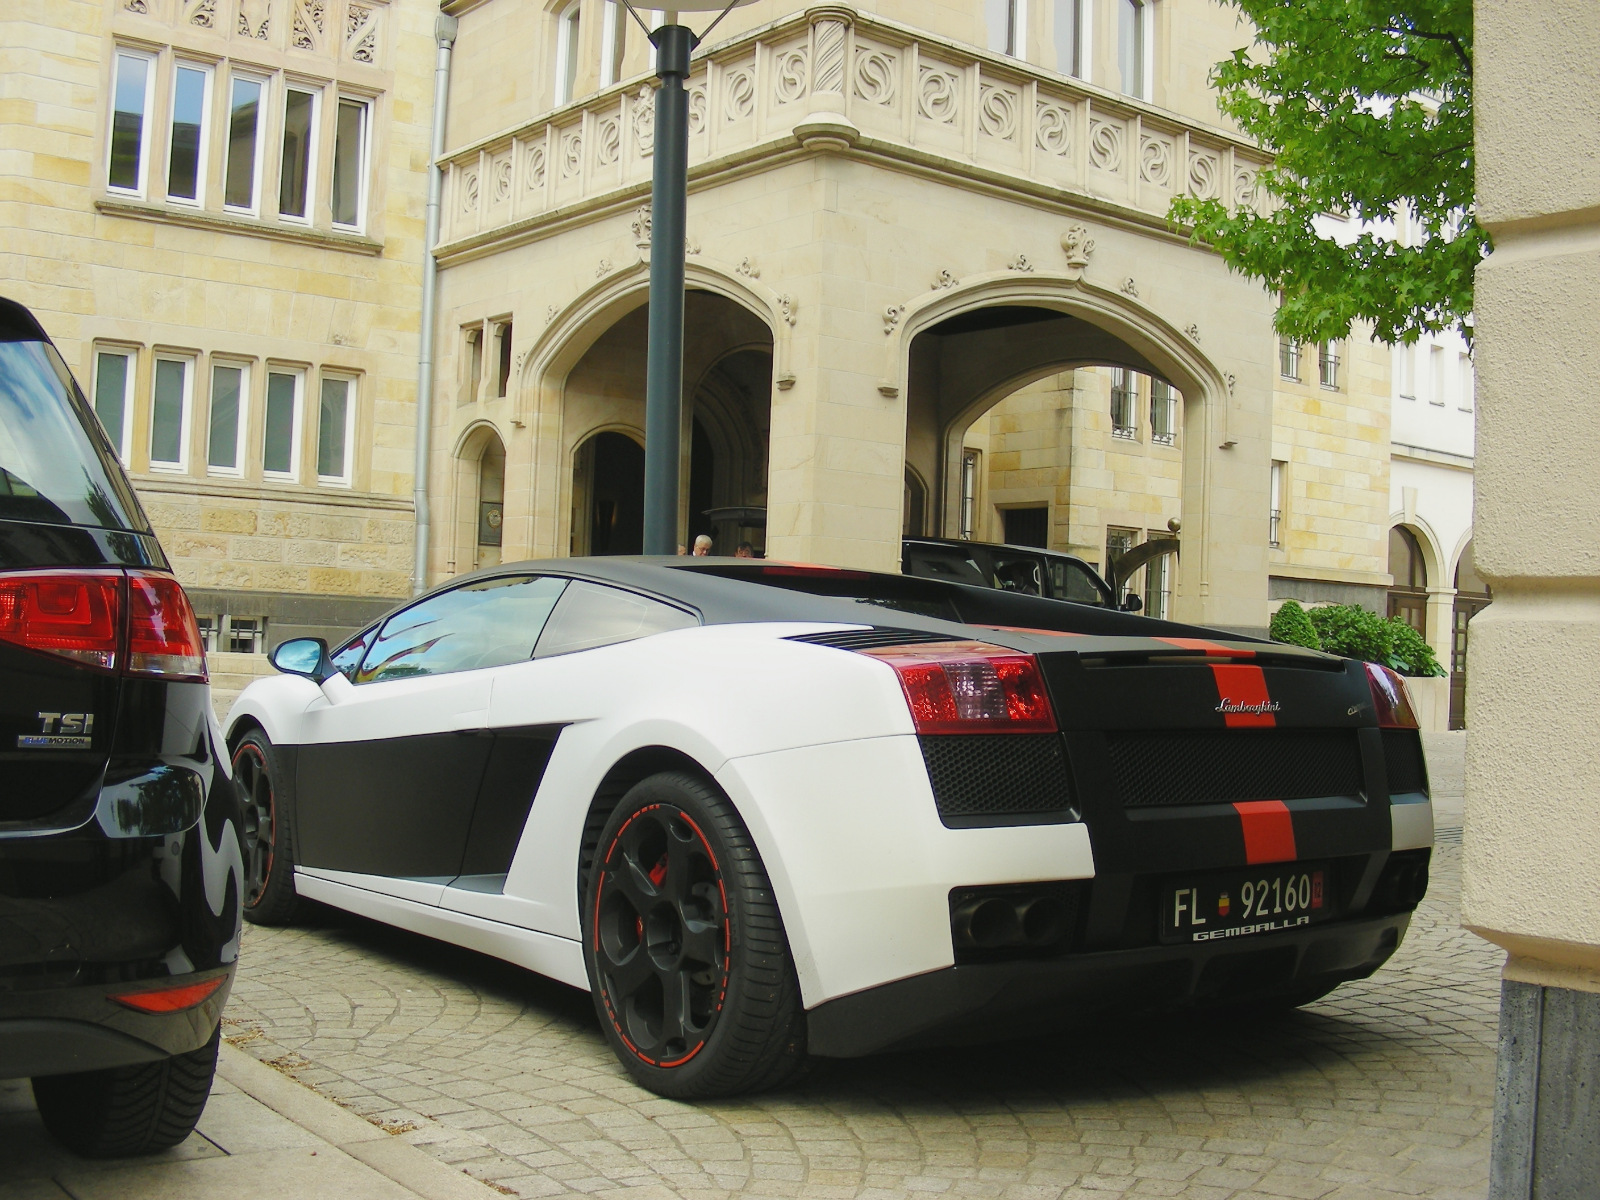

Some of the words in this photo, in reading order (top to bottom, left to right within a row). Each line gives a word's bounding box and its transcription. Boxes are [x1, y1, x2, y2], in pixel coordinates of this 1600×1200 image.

[1214, 697, 1281, 715] Lamborghini
[38, 711, 95, 733] TSI
[23, 737, 86, 745] BLUEMOTION
[1174, 887, 1207, 928] FL
[1241, 873, 1311, 919] 92160
[1192, 915, 1310, 942] GEMBALLA
